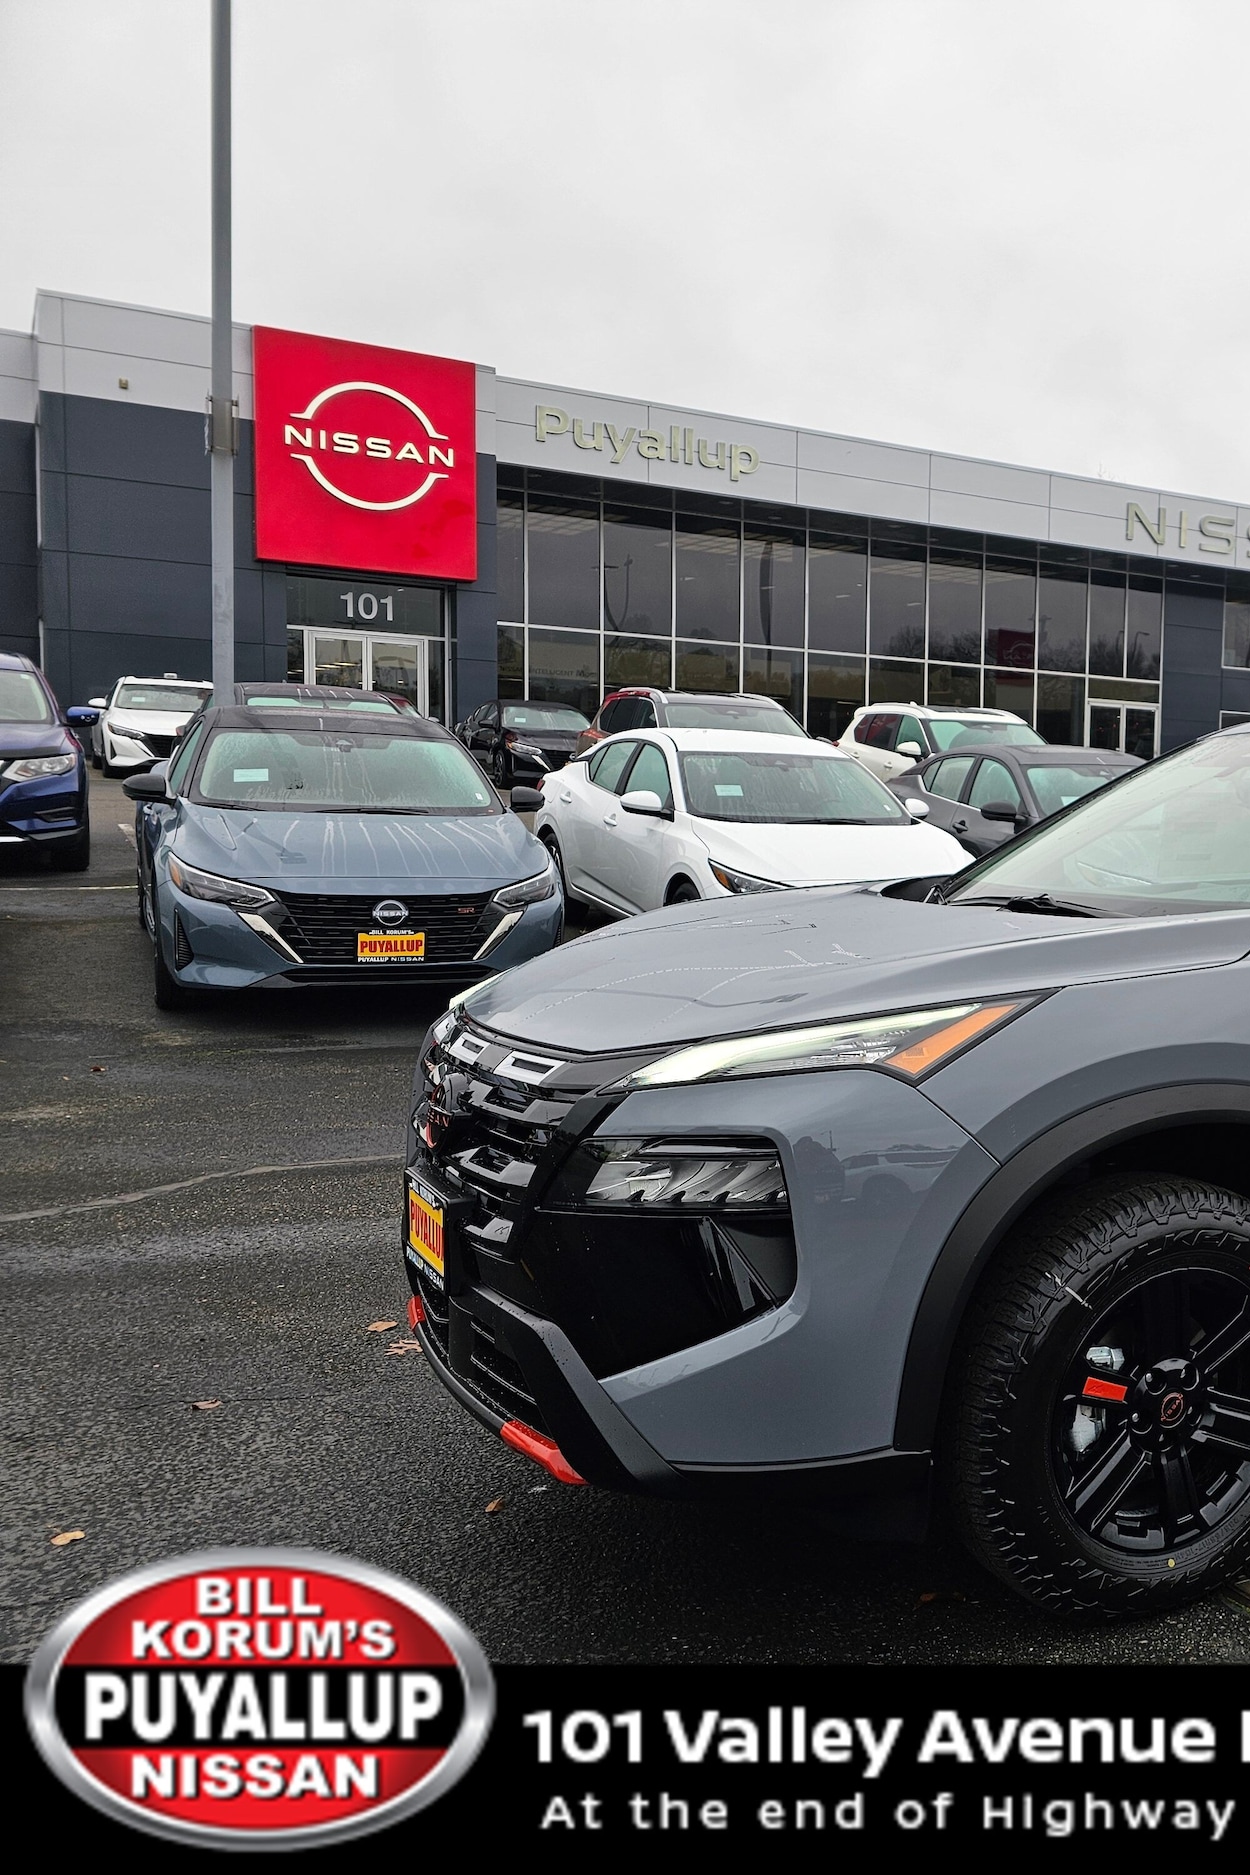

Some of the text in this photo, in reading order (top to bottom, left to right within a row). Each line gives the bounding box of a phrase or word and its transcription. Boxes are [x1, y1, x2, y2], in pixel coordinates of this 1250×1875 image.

[283, 423, 456, 468] NISSAN
[535, 404, 762, 482] Puyallup
[339, 591, 394, 622] 101
[372, 909, 409, 917] NISSAN
[359, 939, 424, 954] PUYALLUP
